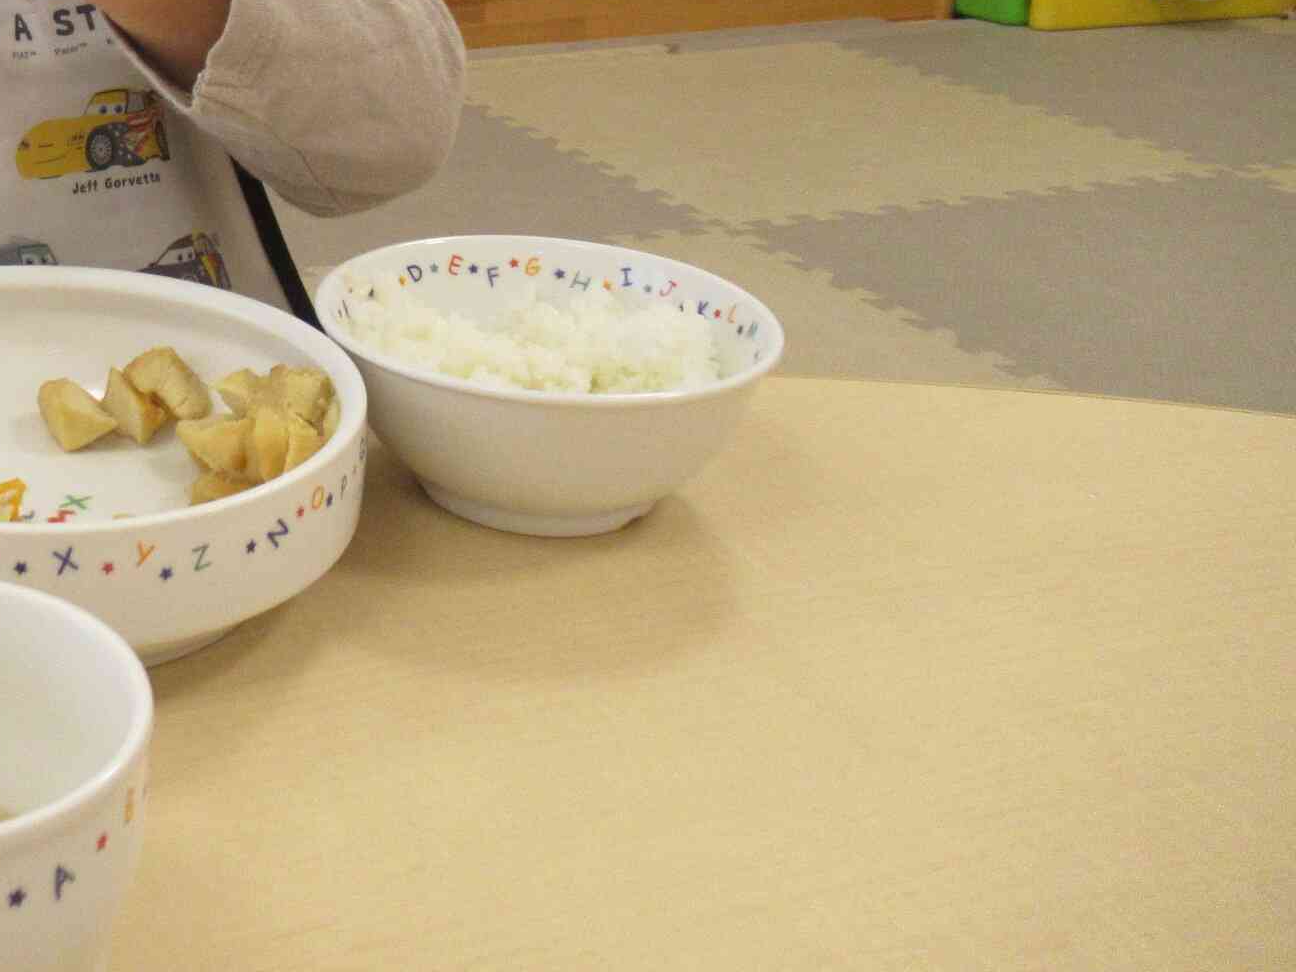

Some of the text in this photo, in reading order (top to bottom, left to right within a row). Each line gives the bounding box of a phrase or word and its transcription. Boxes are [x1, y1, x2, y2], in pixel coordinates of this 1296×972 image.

[14, 13, 32, 41] A
[72, 179, 98, 194] Jeff
[407, 264, 423, 282] D
[448, 254, 463, 276] E
[487, 266, 499, 288] F
[525, 257, 542, 277] G
[569, 270, 591, 292] H
[621, 267, 633, 287] I
[660, 280, 678, 297] J
[53, 546, 79, 576] X
[136, 540, 156, 568] Y
[191, 543, 212, 572] Z
